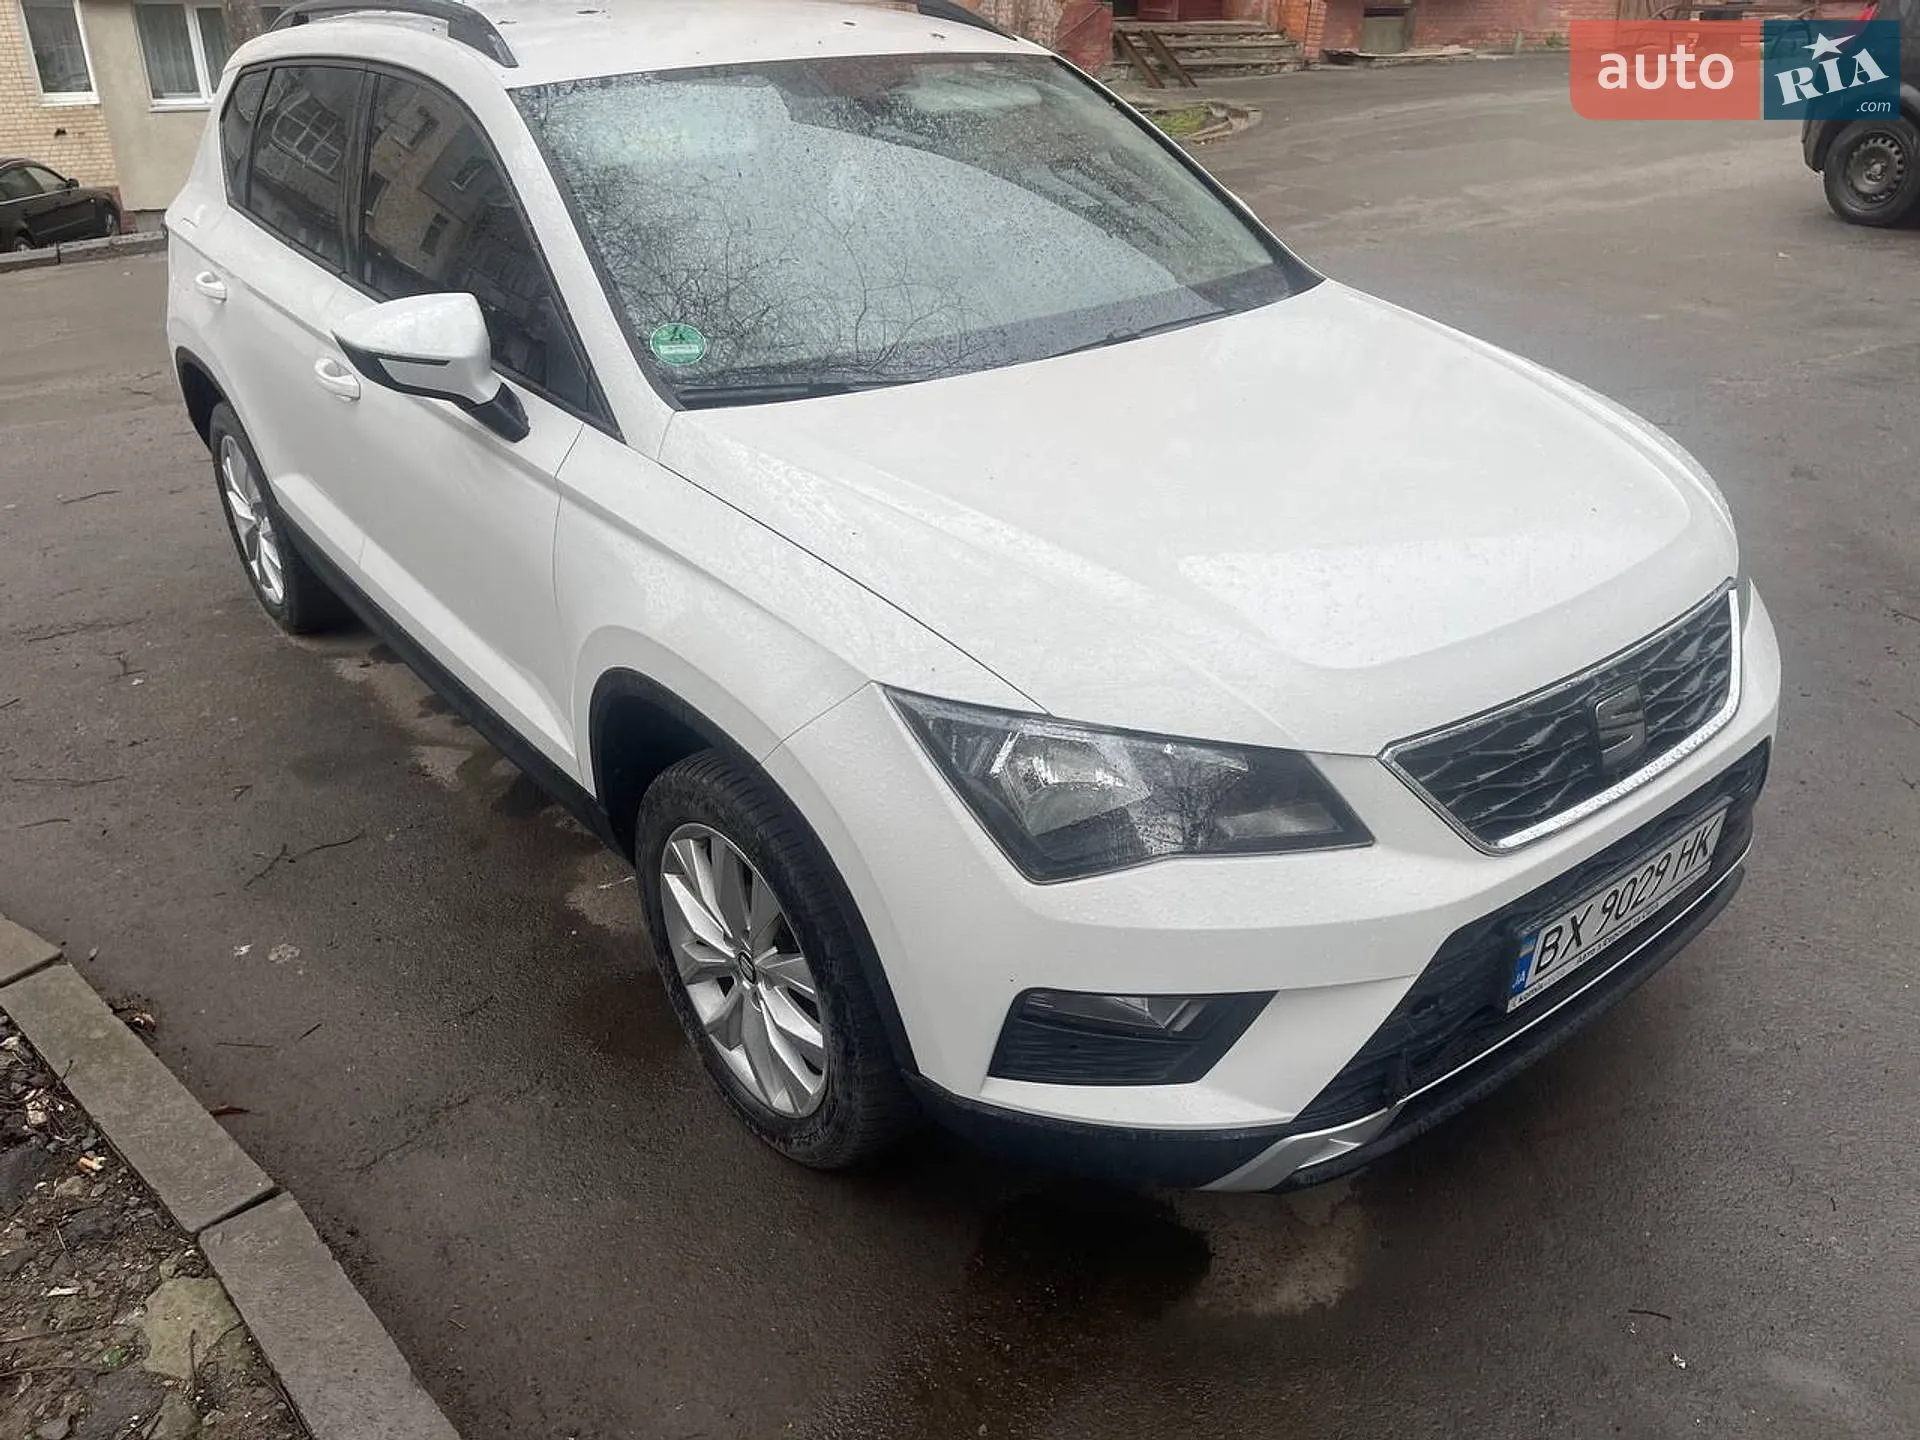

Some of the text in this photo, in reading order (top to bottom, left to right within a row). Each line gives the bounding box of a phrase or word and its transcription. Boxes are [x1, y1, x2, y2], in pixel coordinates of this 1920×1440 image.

[1535, 904, 1593, 975] BX
[1595, 852, 1671, 937] 9029
[1672, 817, 1719, 880] HK
